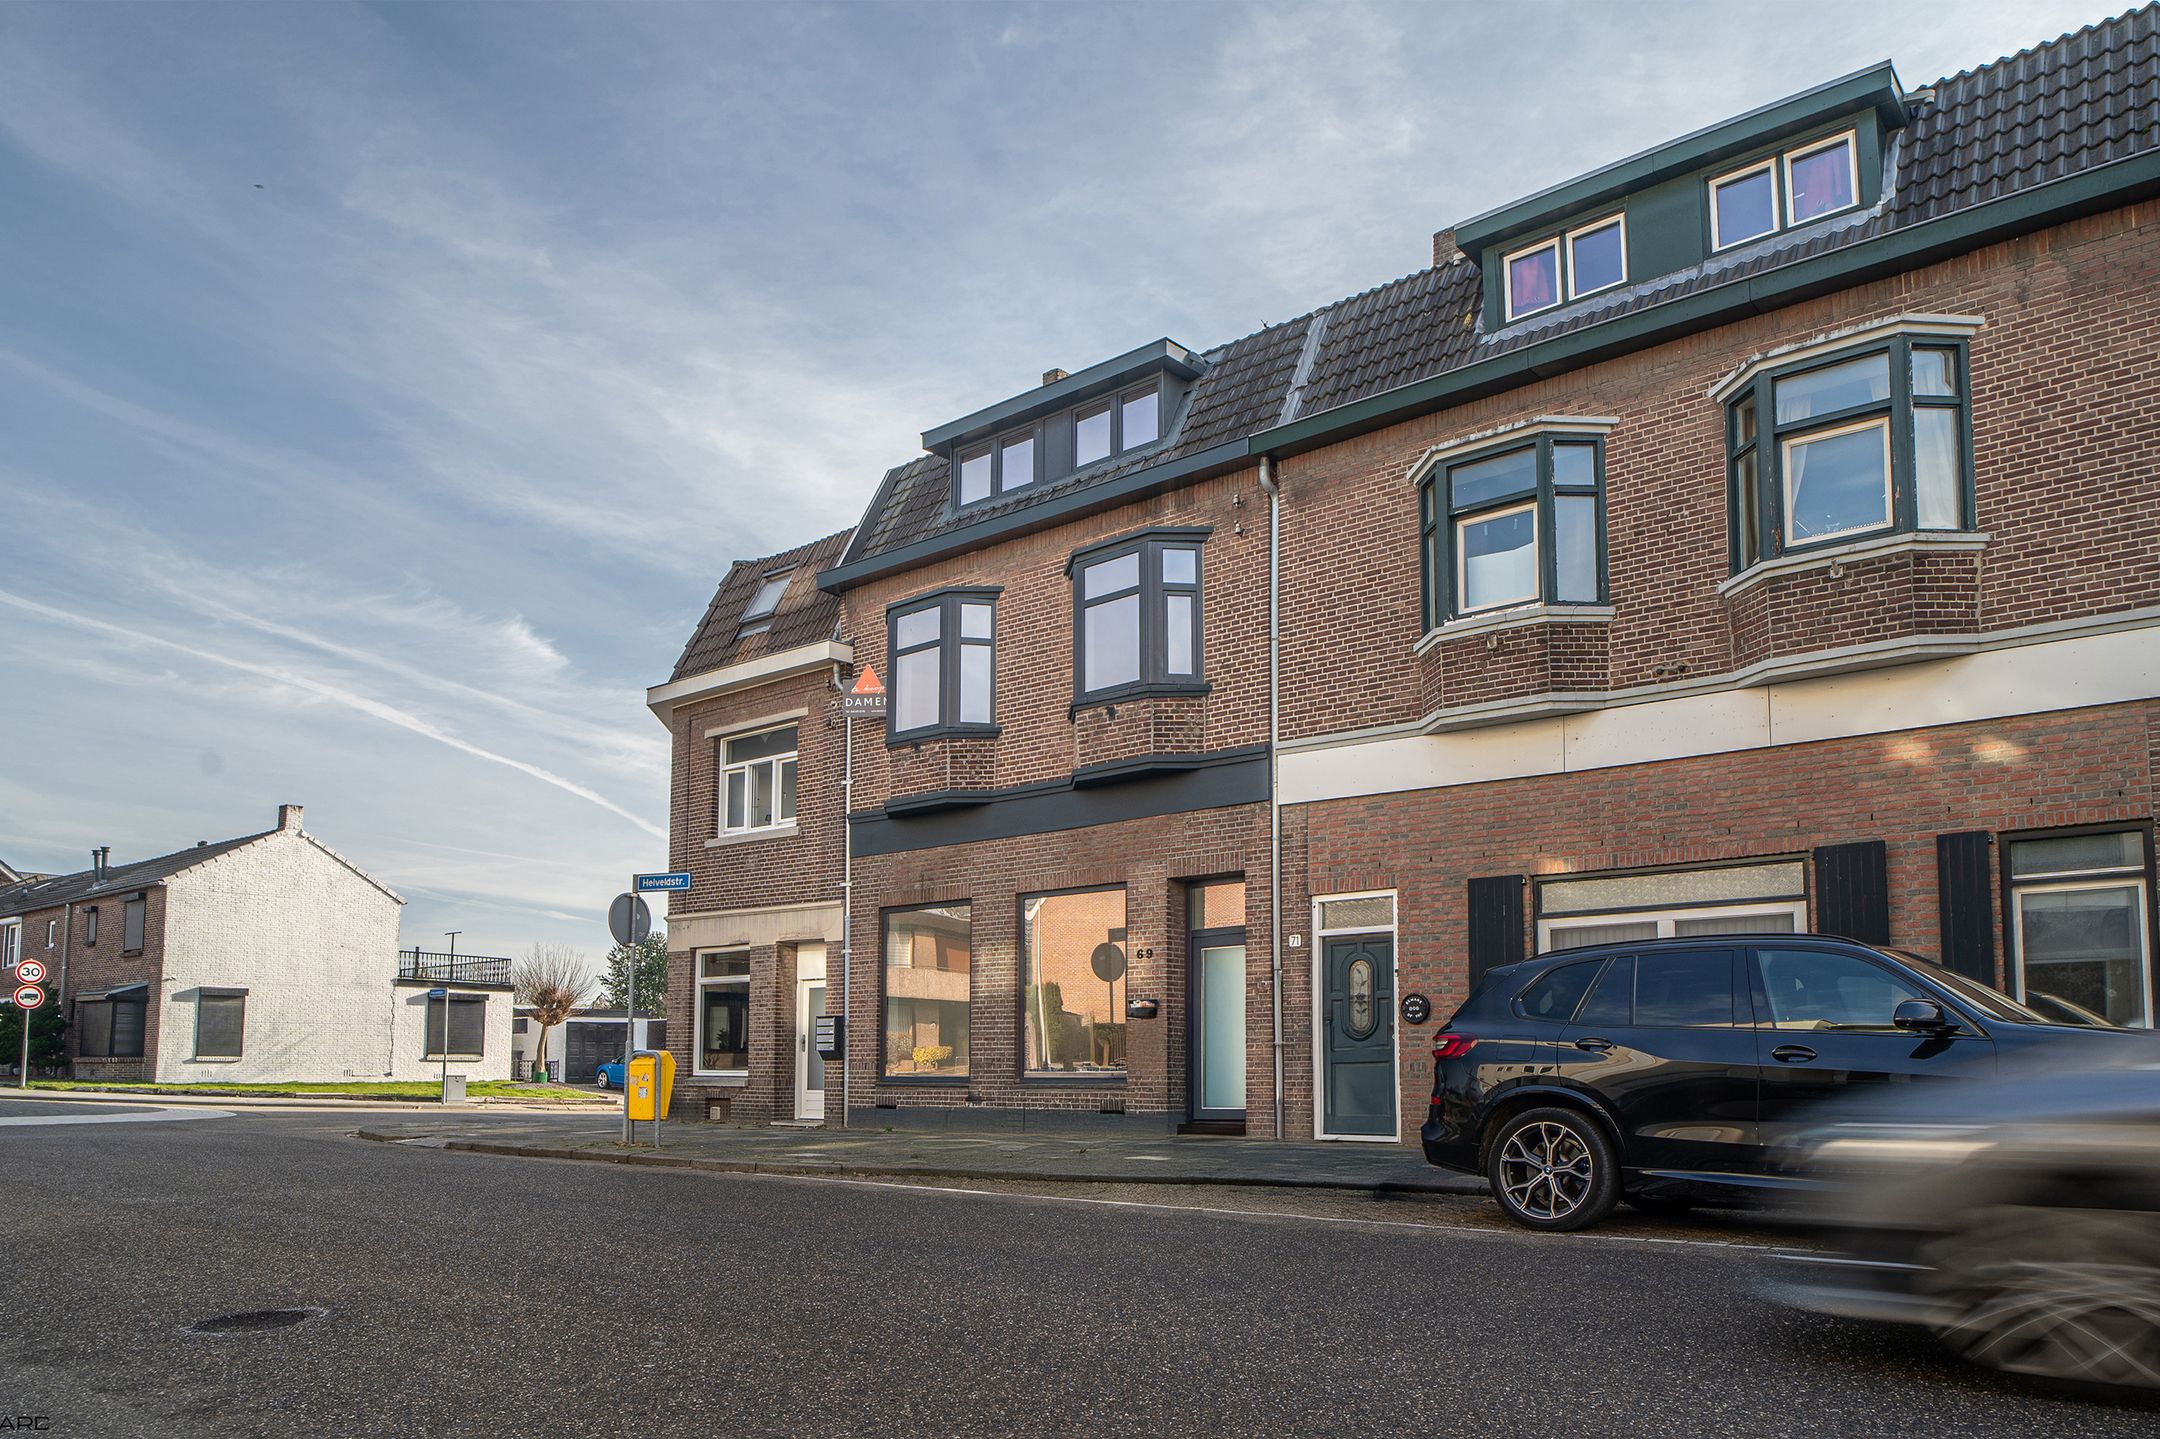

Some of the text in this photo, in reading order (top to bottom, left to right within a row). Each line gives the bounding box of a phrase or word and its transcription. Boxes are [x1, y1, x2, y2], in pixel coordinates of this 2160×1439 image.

[1291, 936, 1299, 945] 71
[1137, 949, 1153, 959] 69
[22, 967, 40, 977] 30
